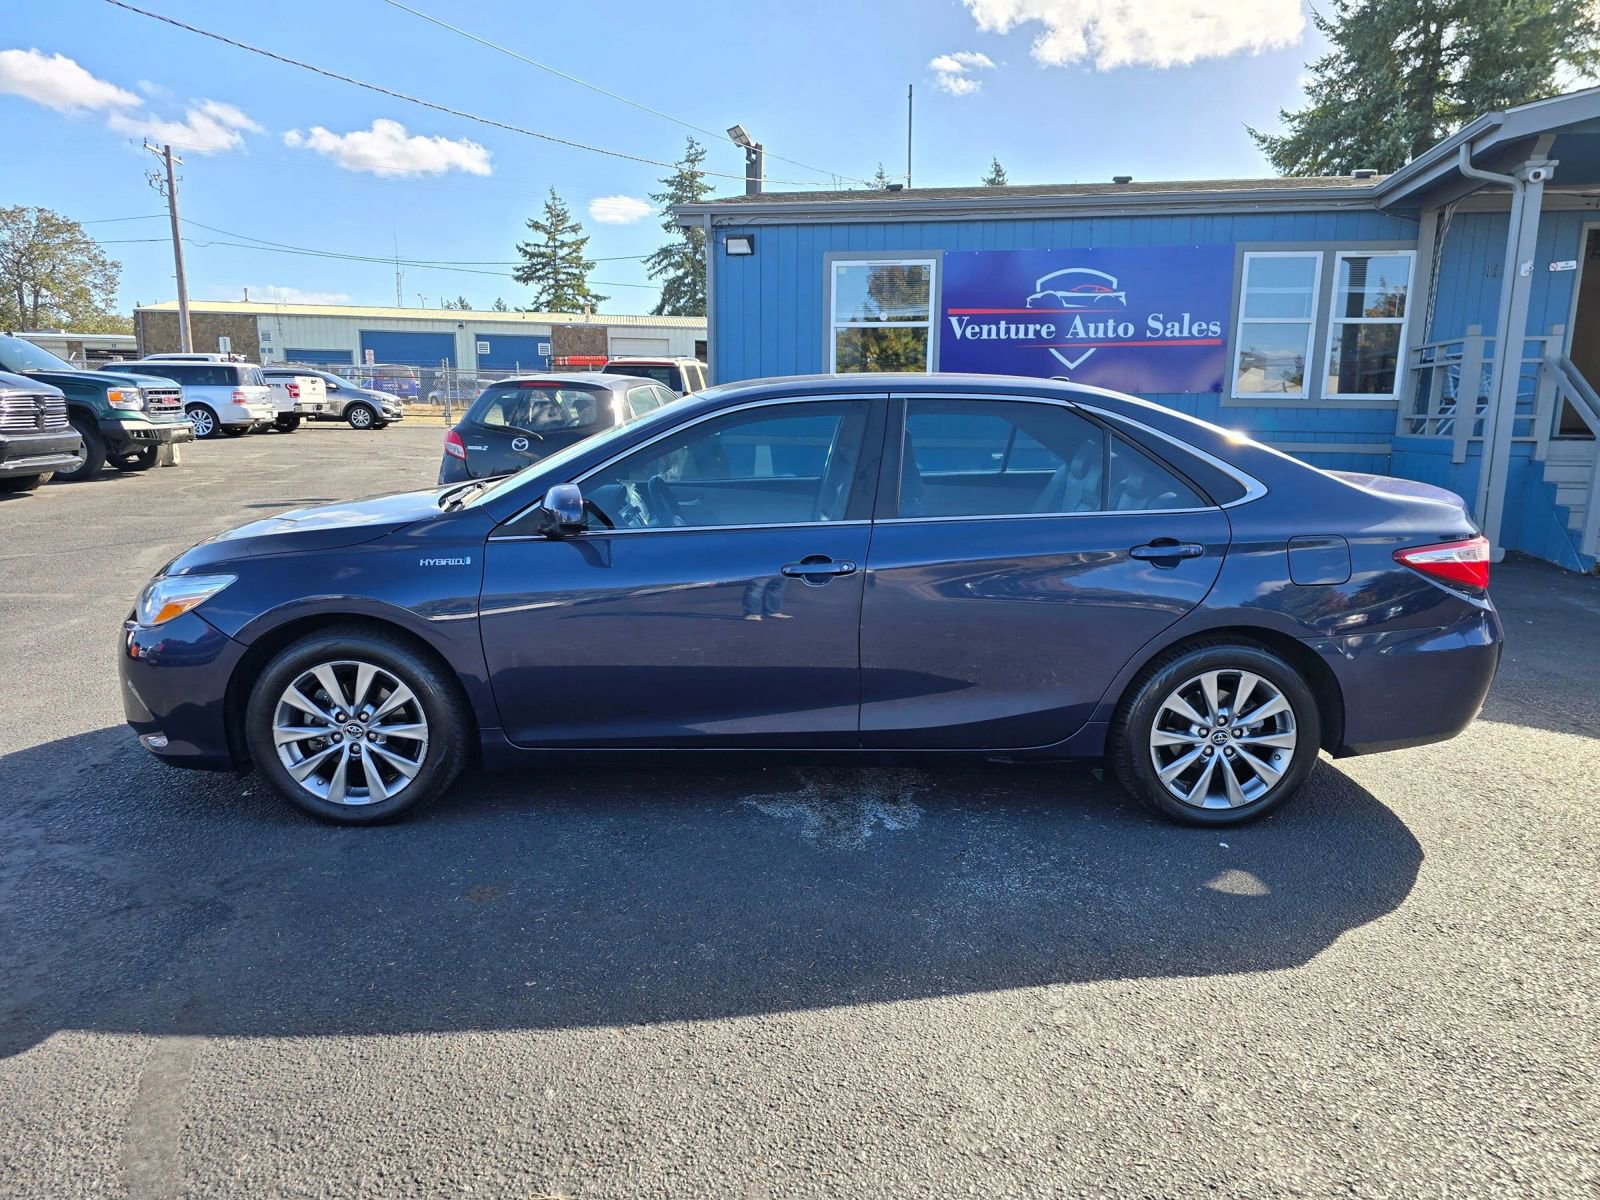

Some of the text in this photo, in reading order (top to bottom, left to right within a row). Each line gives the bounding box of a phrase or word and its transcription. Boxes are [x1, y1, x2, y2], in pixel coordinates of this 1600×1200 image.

[948, 312, 1221, 340] Venture Auto Sales
[420, 558, 465, 566] HYBRID
